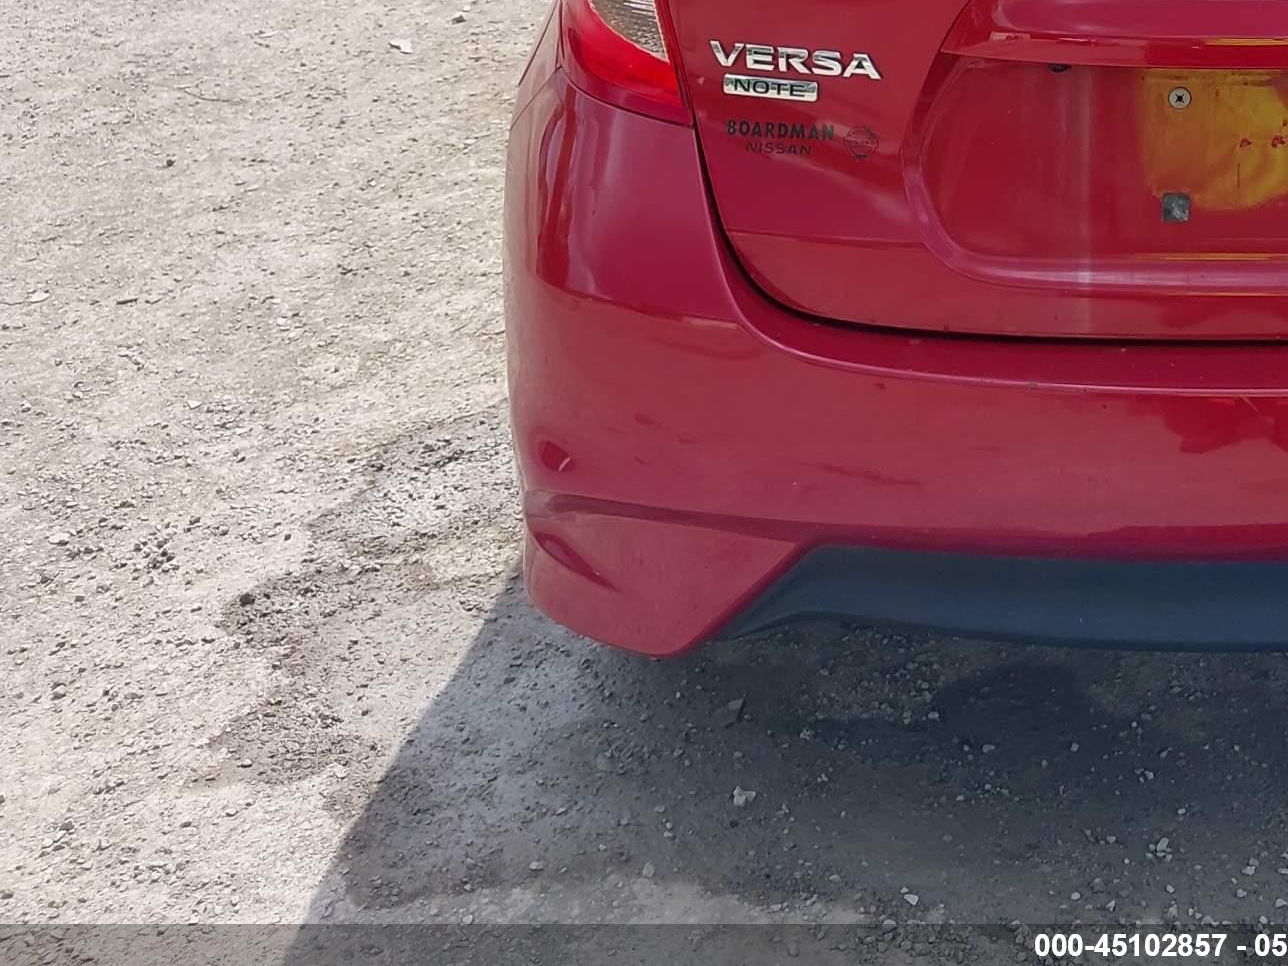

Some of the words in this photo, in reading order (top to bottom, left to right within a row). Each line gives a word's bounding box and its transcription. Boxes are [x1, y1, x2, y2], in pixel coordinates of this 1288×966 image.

[710, 40, 881, 80] VERSA
[733, 79, 805, 98] NOTE
[727, 121, 835, 139] BOARDMAN
[745, 141, 812, 155] NISSAN
